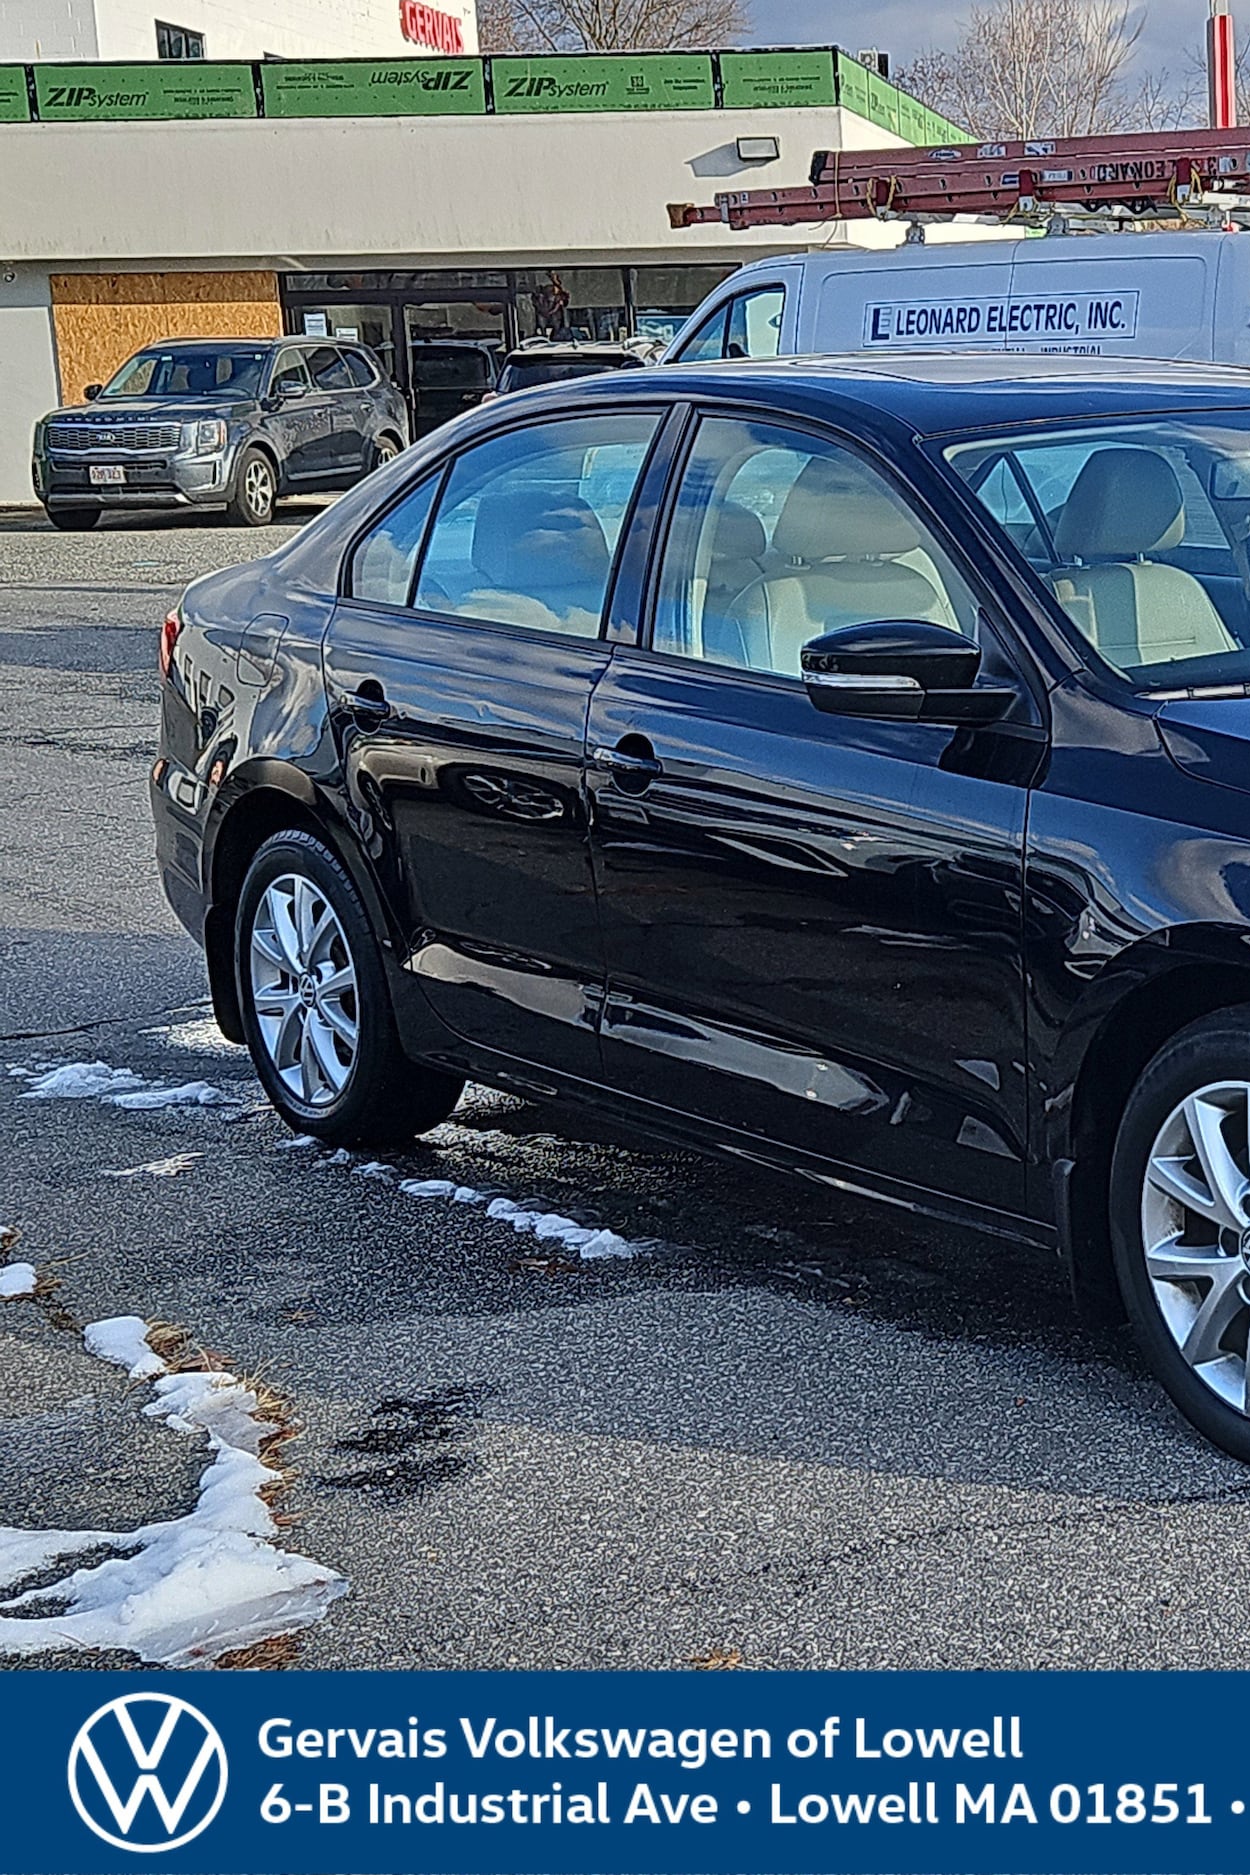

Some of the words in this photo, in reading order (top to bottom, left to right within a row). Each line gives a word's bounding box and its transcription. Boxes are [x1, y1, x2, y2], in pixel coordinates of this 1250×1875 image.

[402, 0, 464, 55] GERVAIS
[895, 306, 981, 336] LEONARD
[986, 302, 1080, 335] ELECTRIC,
[1087, 300, 1126, 330] INC.
